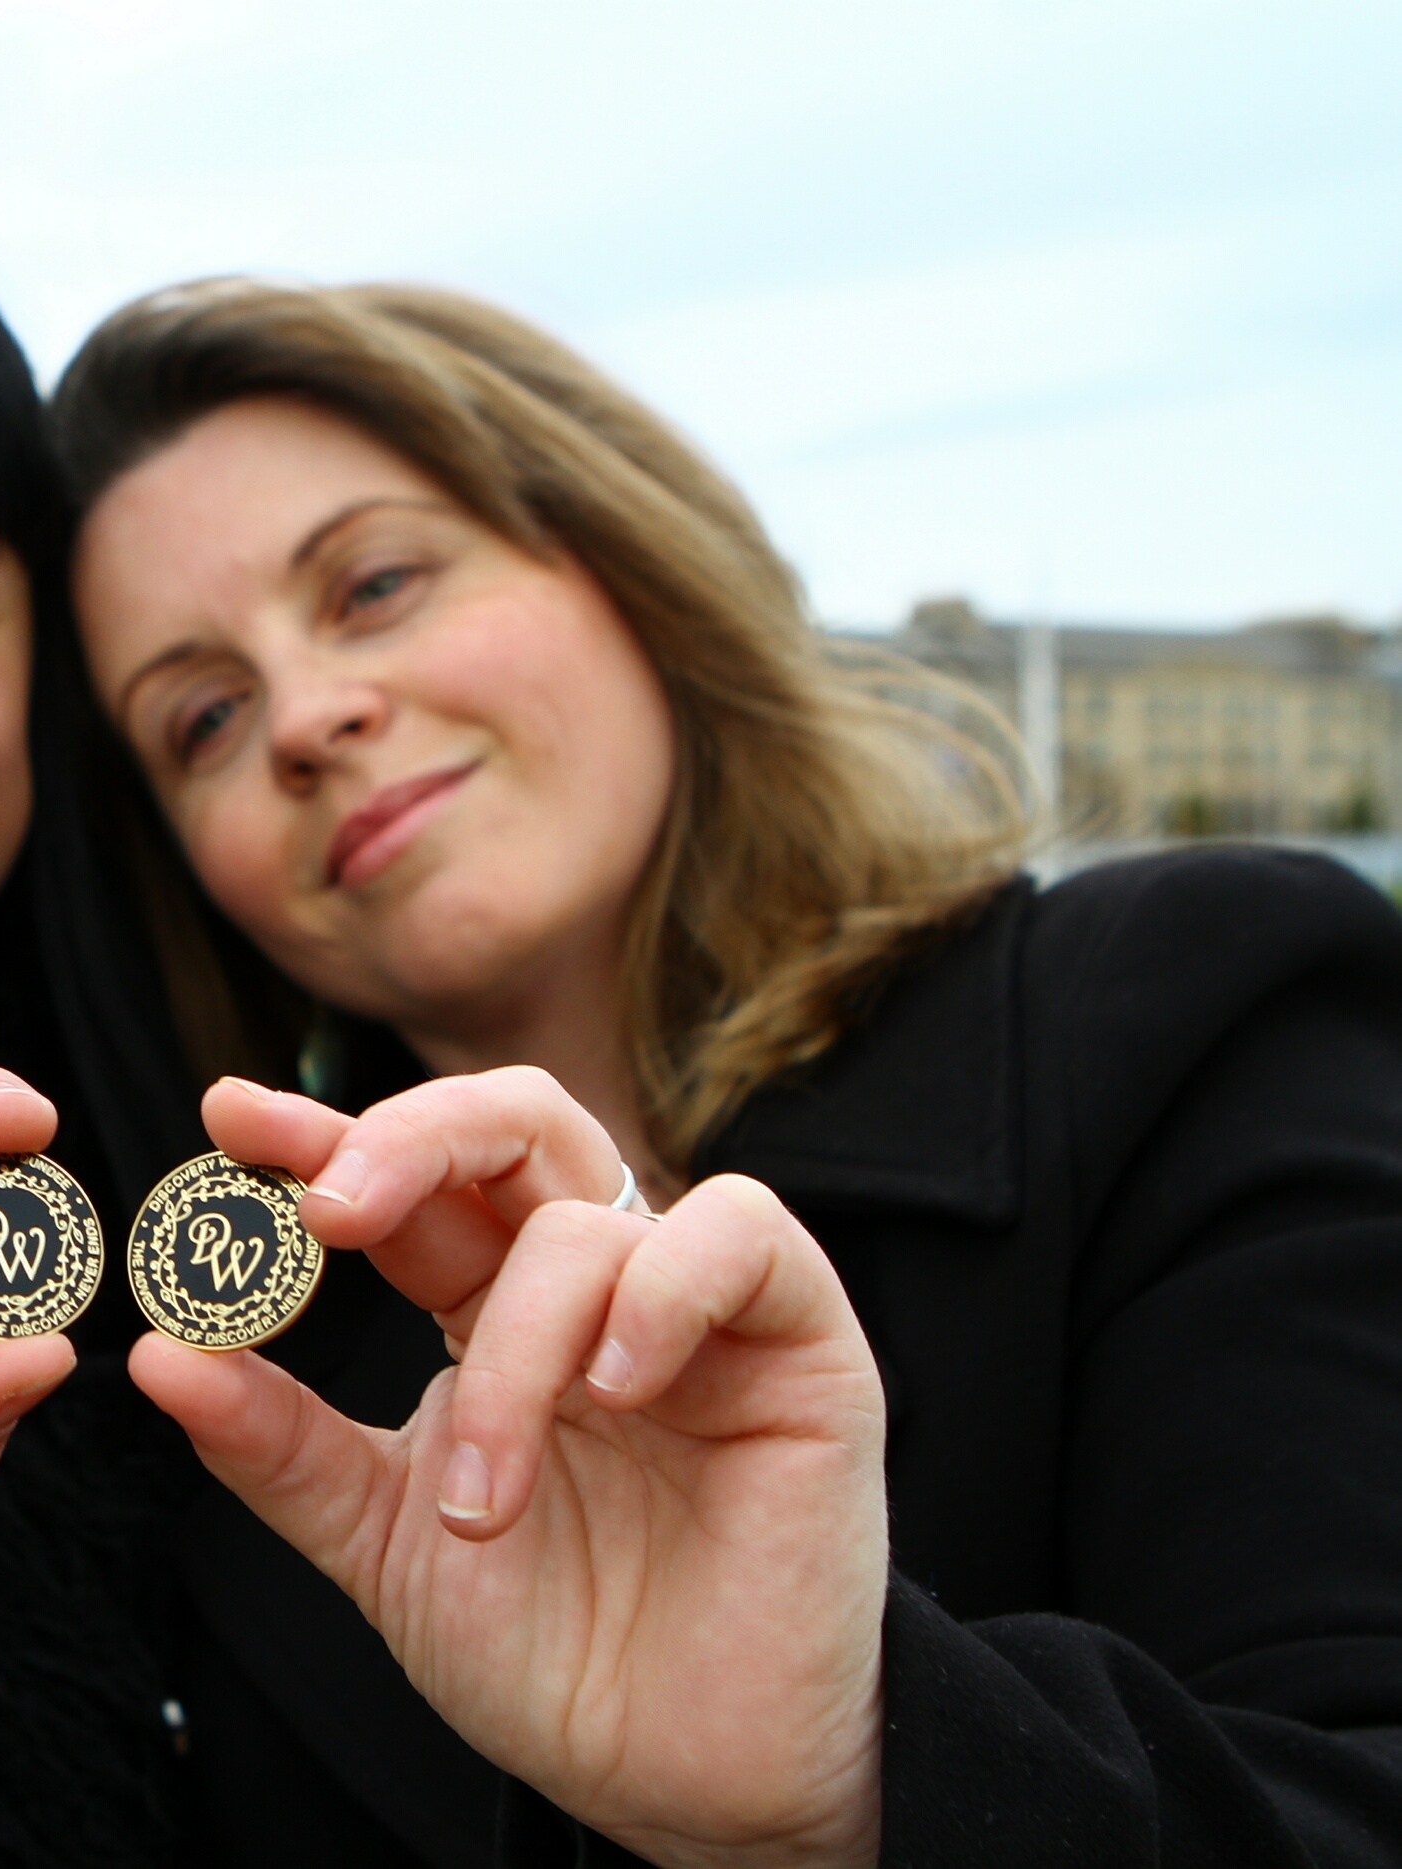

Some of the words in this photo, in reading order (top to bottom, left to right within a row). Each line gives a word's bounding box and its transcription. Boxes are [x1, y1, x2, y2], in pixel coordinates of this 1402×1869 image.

[148, 1158, 215, 1213] DISCOVERY
[83, 1217, 100, 1254] ENDS
[132, 1241, 145, 1267] THE
[76, 1259, 100, 1302] NEVER
[278, 1271, 313, 1316] NEVER
[10, 1299, 80, 1337] DISCOVERY
[132, 1267, 185, 1337] ADVENTURE
[185, 1328, 204, 1342] OF
[205, 1311, 279, 1345] DISCOVERY
